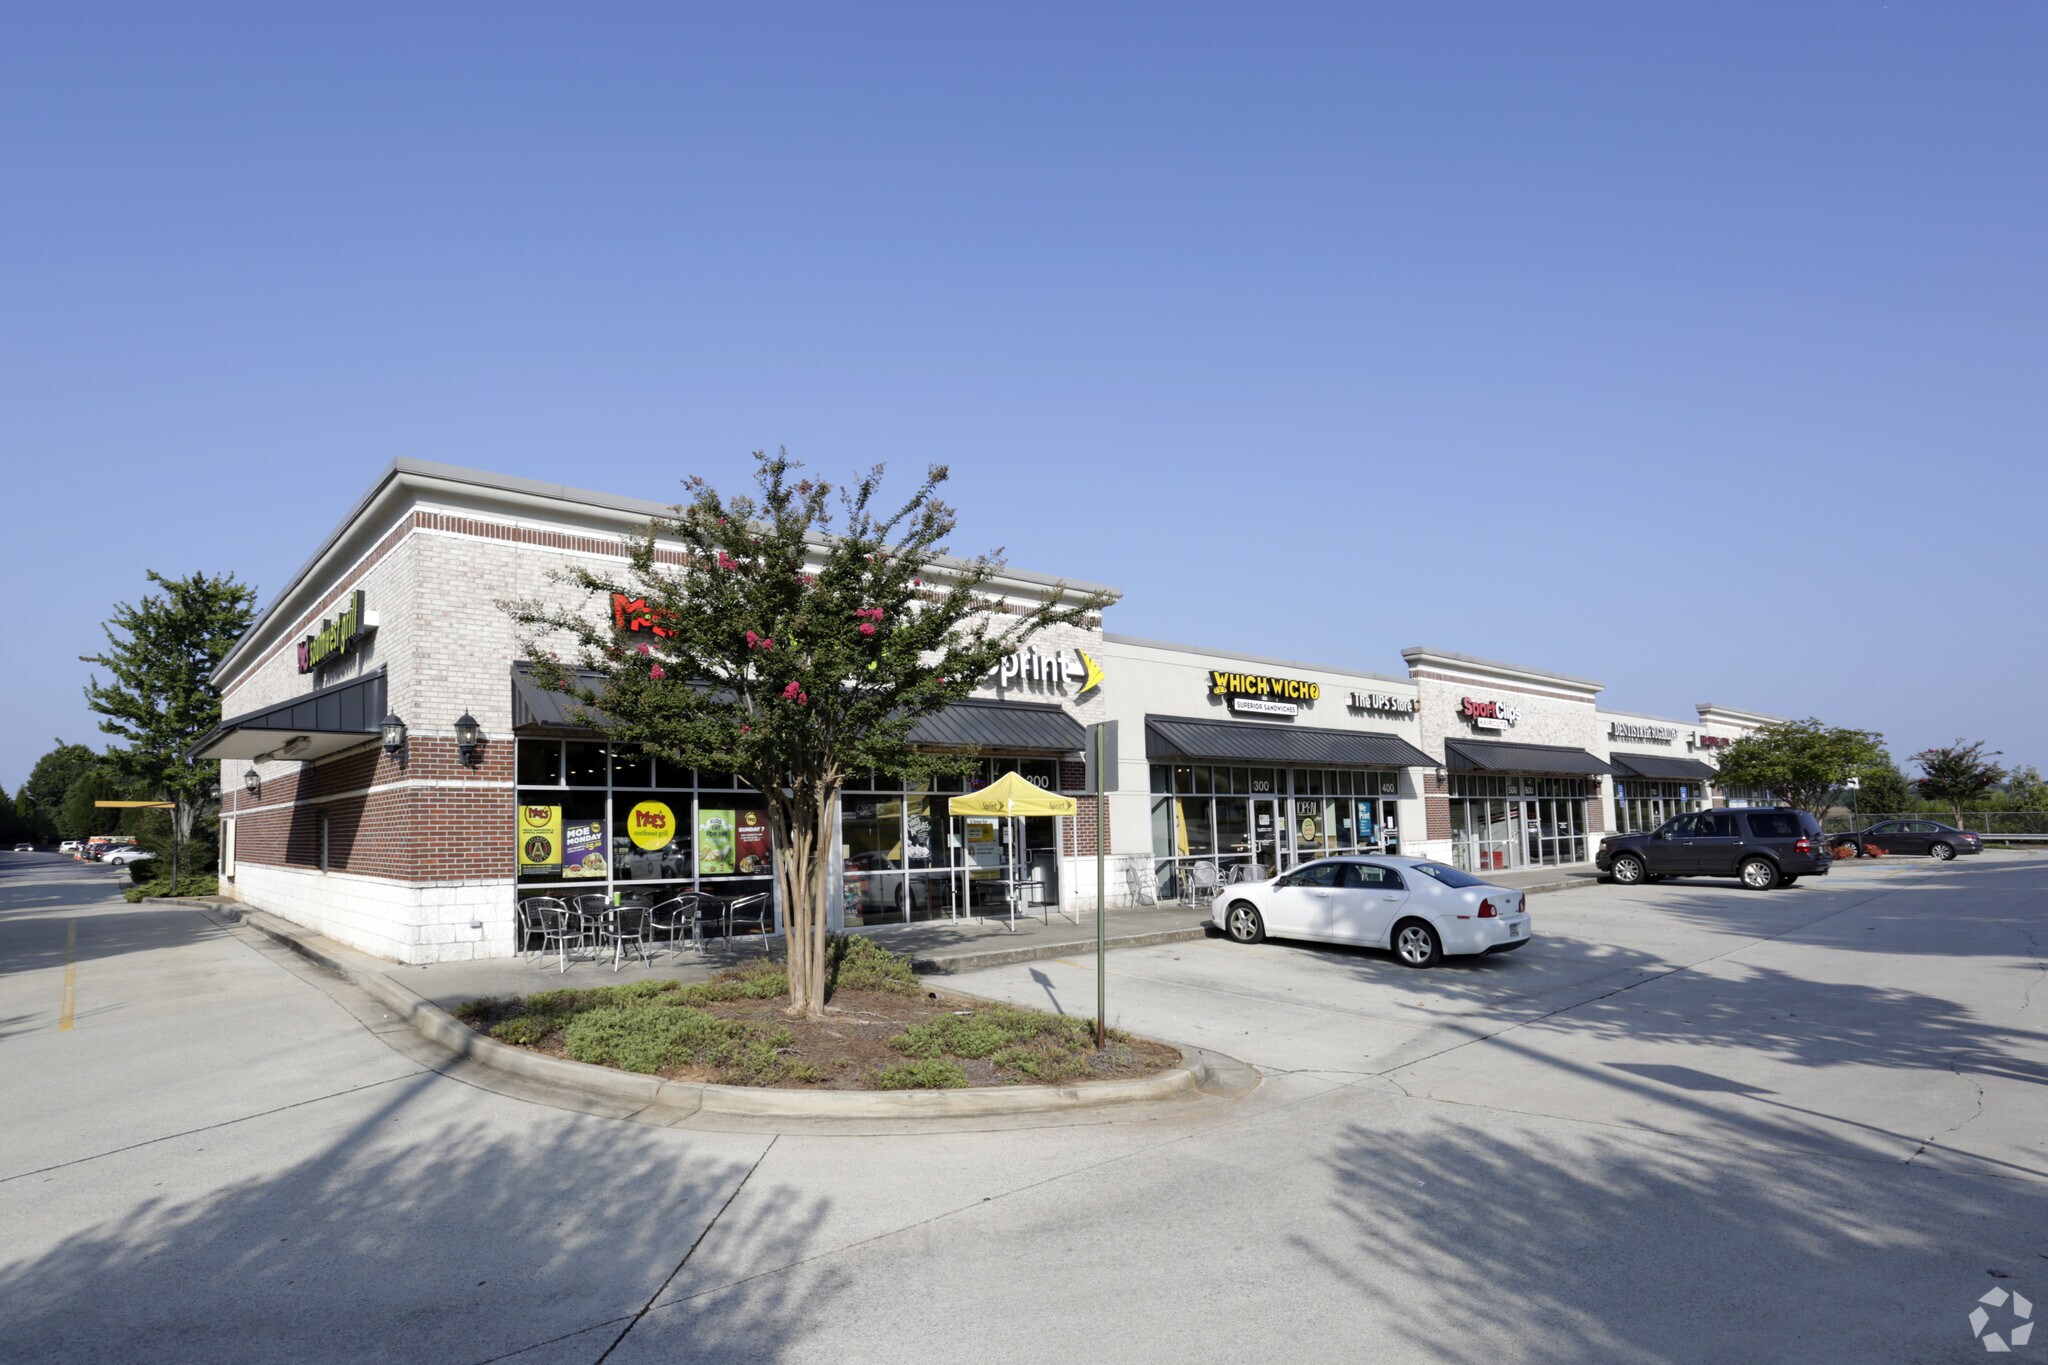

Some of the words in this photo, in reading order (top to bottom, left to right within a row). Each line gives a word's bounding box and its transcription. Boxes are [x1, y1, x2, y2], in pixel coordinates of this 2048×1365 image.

[988, 645, 1072, 687] print
[1213, 671, 1267, 695] WHICH
[1237, 701, 1263, 710] SUPERIOR
[1263, 704, 1296, 714] SANDWICHES
[1354, 692, 1371, 708] The
[1372, 694, 1390, 710] UPS
[1391, 697, 1413, 712] Store
[1614, 722, 1646, 738] DENTISTRY
[1026, 775, 1049, 789] 200
[1253, 781, 1270, 791] 300
[1381, 783, 1394, 792] 400
[982, 801, 997, 811] Sprint
[1048, 802, 1066, 810] Sprint
[1298, 801, 1316, 815] OPEN
[567, 827, 590, 839] MOE
[567, 832, 602, 846] MONDAY
